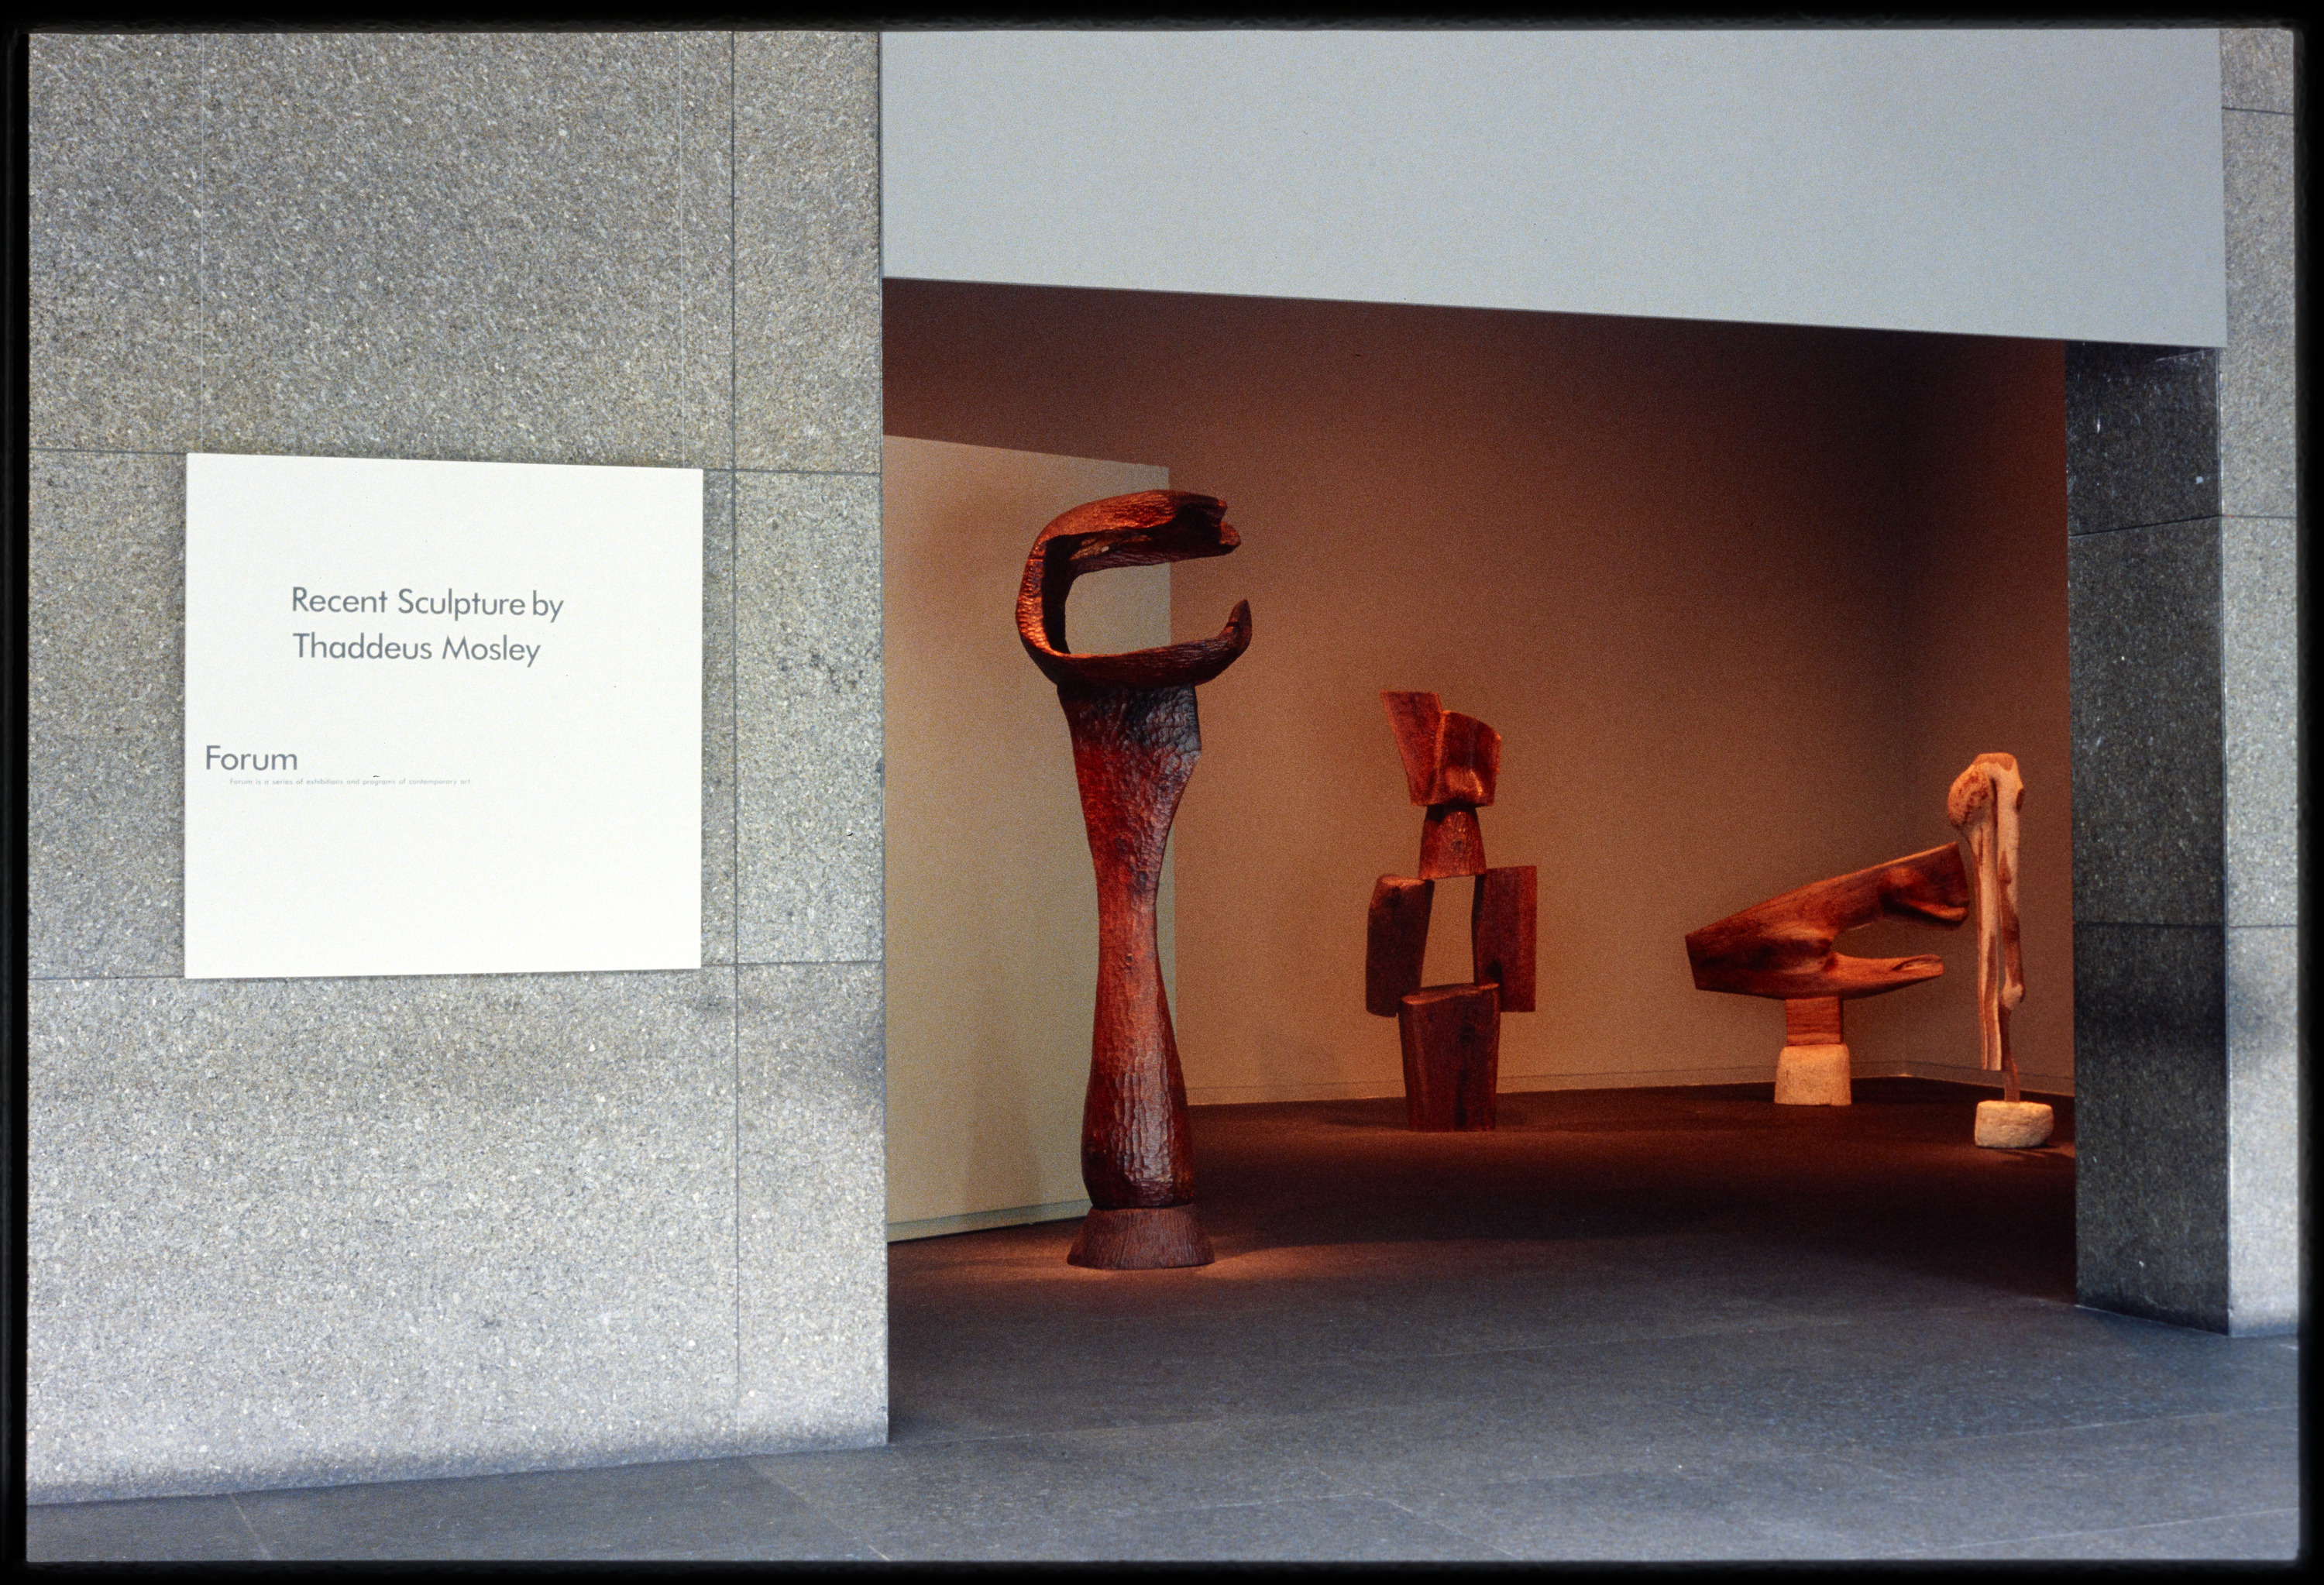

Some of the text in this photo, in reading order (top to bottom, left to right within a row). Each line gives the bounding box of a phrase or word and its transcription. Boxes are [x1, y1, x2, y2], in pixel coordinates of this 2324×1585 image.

[293, 586, 563, 622] Recent Sculpture by
[293, 631, 541, 667] Thaddeus Mosley
[205, 744, 297, 771] Forum
